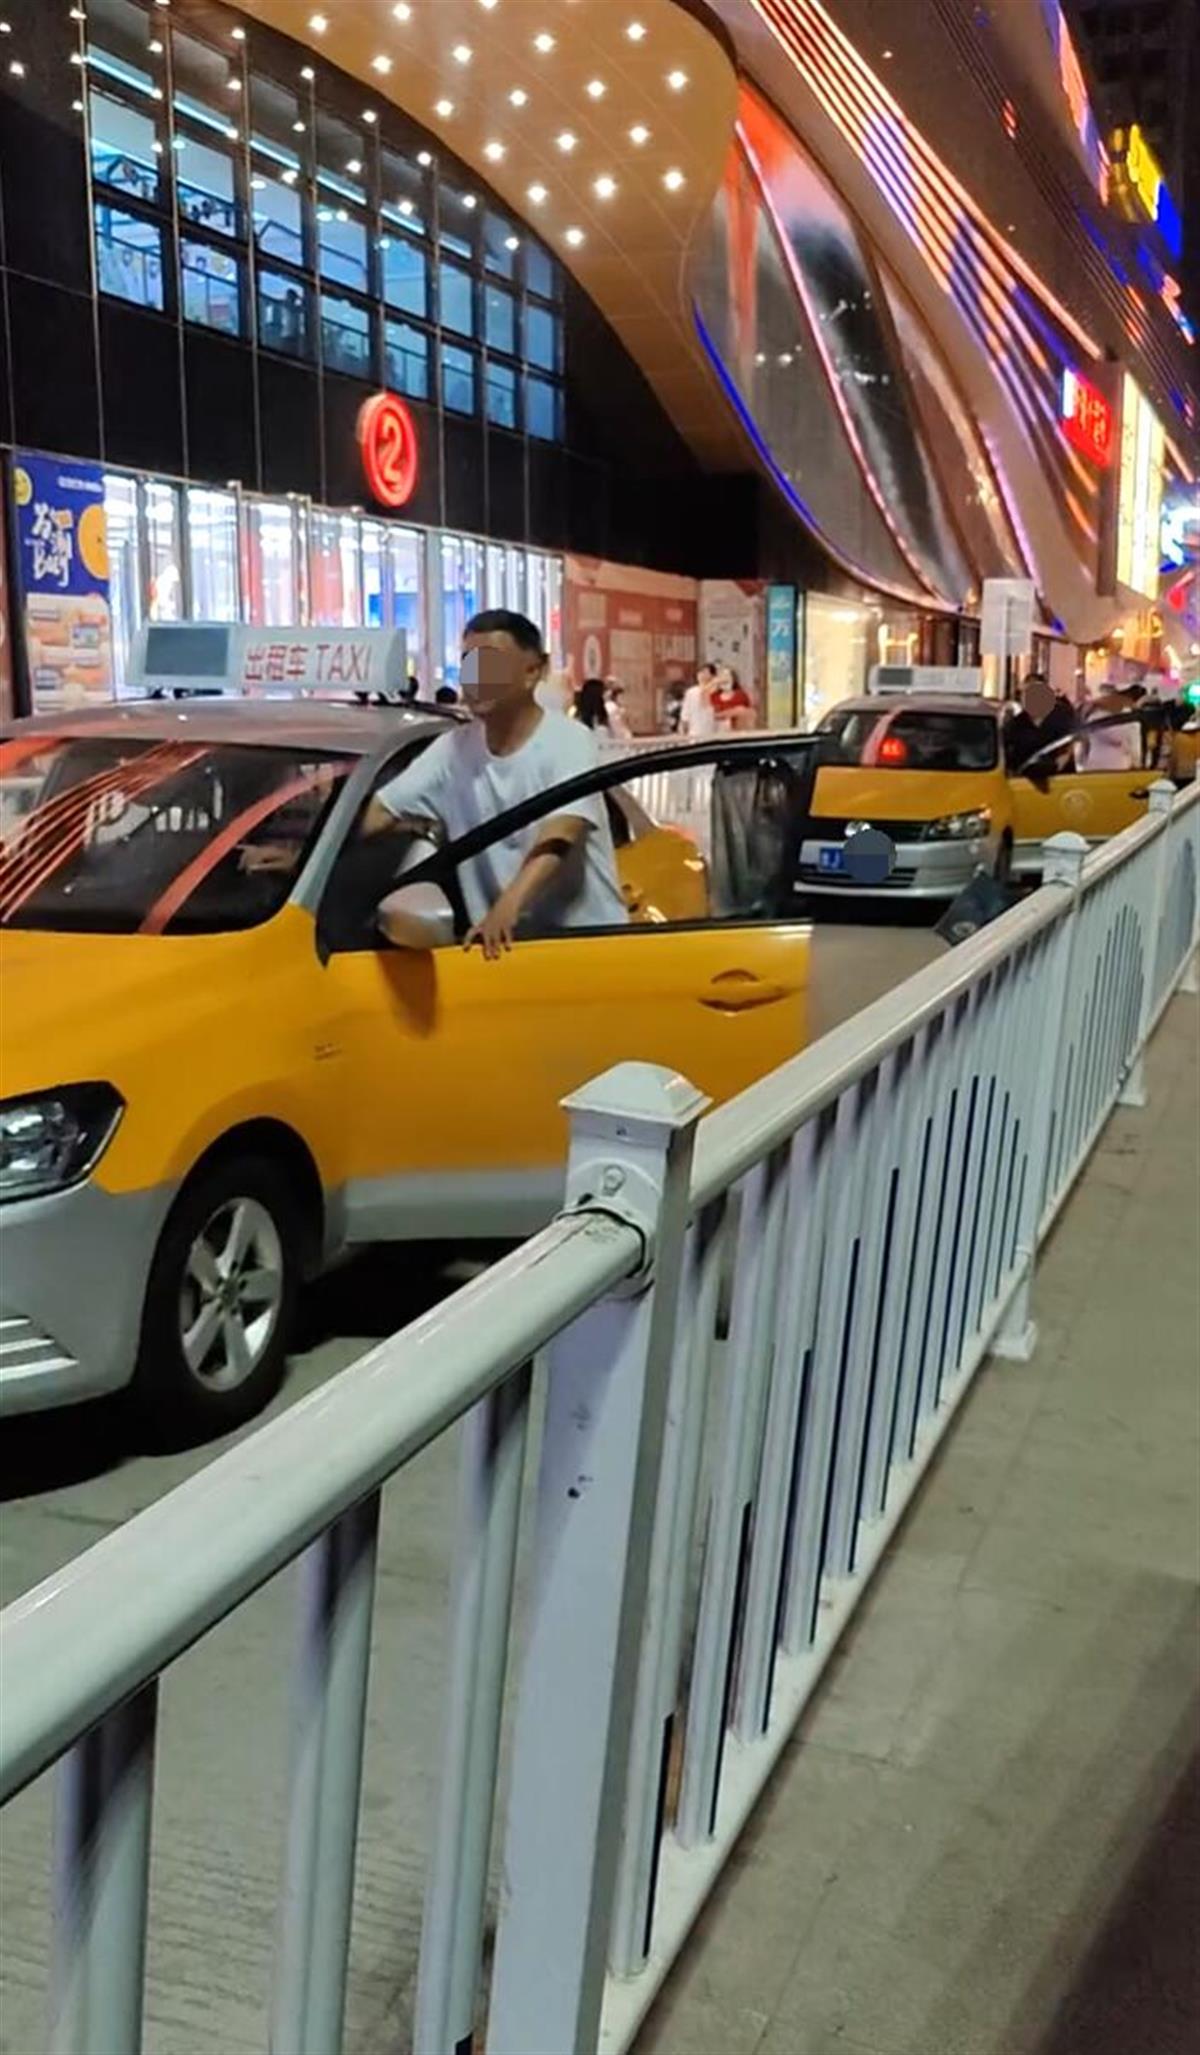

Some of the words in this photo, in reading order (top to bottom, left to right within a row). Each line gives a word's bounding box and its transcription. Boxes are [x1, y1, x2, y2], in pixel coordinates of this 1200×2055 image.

[245, 643, 308, 681] 出租车
[316, 643, 373, 681] TAXI
